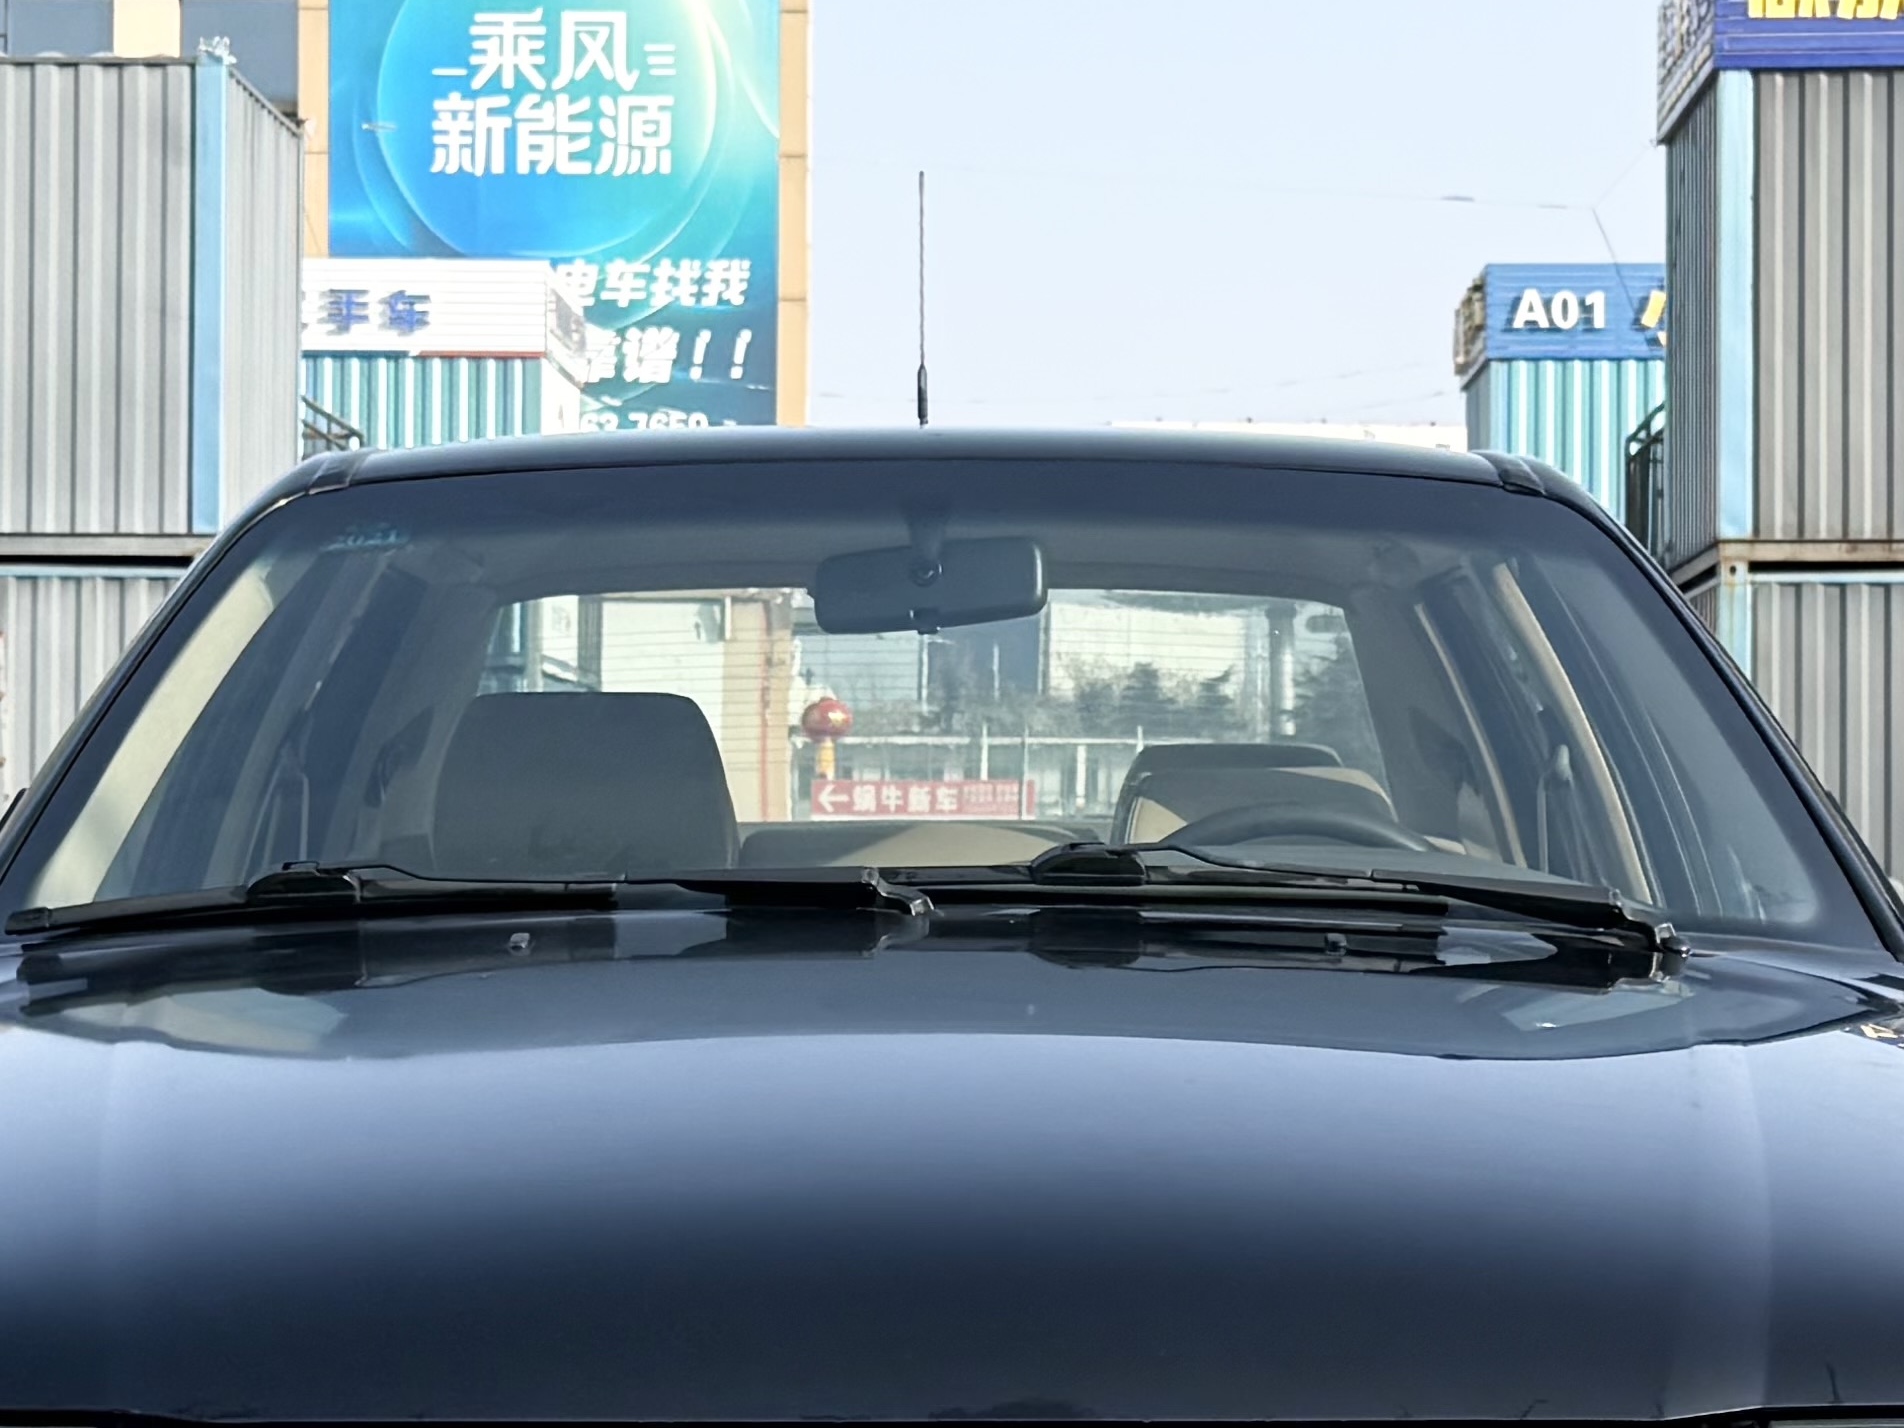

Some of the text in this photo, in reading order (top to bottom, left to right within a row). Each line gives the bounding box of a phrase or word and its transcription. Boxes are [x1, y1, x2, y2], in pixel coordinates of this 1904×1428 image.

[469, 6, 637, 91] 乘风
[430, 92, 674, 176] 新能源
[554, 258, 752, 308] 电车找我
[302, 289, 431, 336] 手车
[1512, 288, 1606, 330] A01
